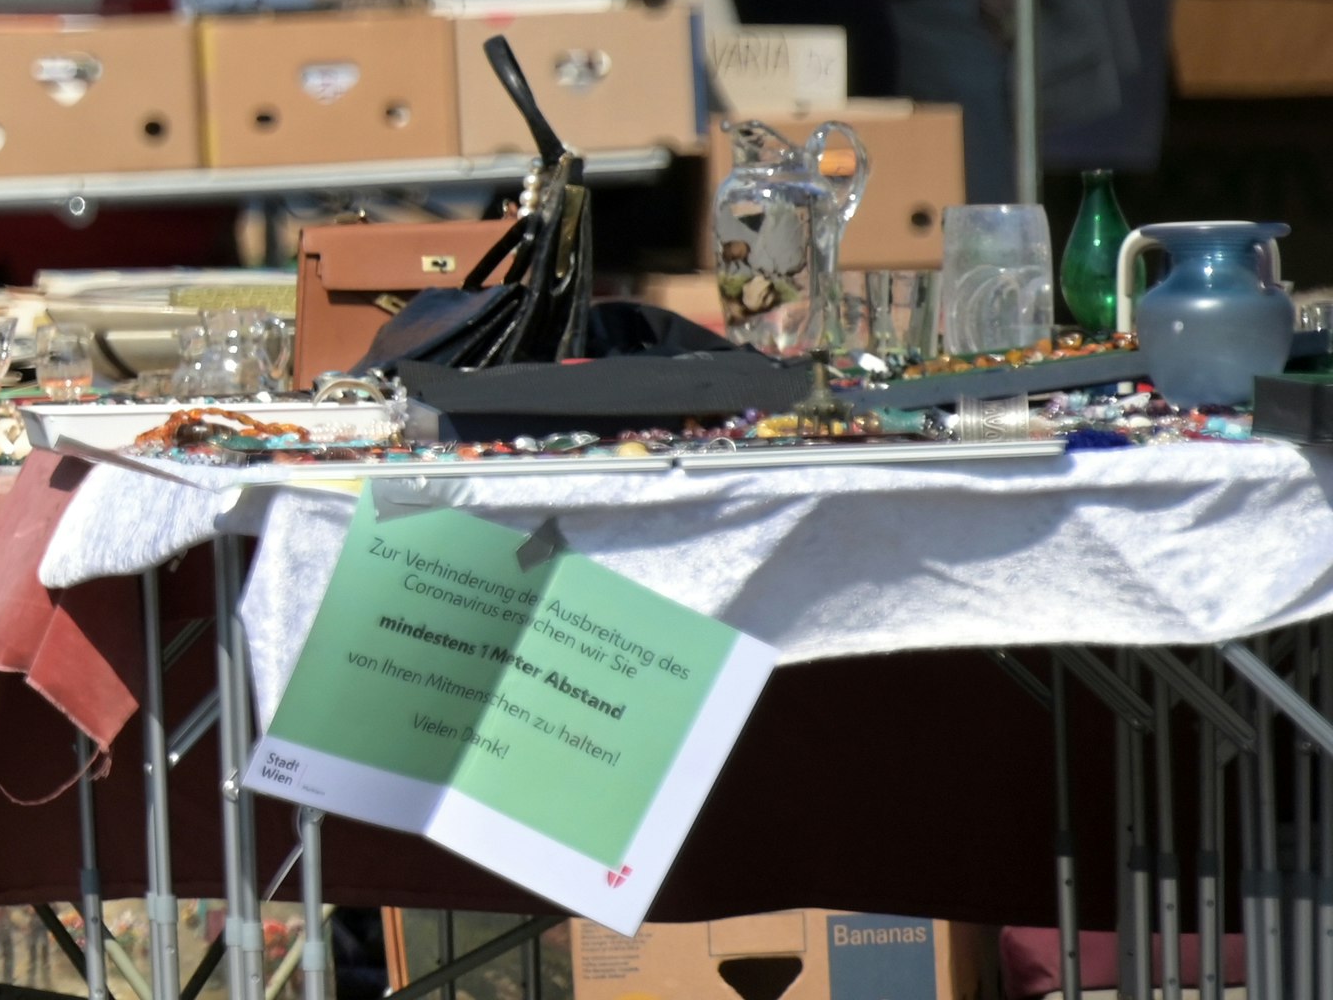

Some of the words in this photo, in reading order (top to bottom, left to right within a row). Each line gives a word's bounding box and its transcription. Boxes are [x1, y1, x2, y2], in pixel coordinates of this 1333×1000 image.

[712, 30, 791, 75] VARIA
[369, 537, 401, 561] Zur
[406, 549, 516, 604] Verhinderung
[546, 600, 656, 667] Ausbreitung
[658, 656, 691, 680] des
[404, 574, 499, 617] Coronavirus
[580, 642, 608, 663] wir
[610, 654, 638, 679] Sie
[379, 615, 477, 655] mindestens
[481, 644, 489, 658] 1
[490, 646, 543, 678] Meter
[544, 671, 627, 720] Abstand
[348, 651, 378, 671] von
[381, 658, 422, 685] Ihren
[425, 673, 531, 723] Mitmenschen
[533, 717, 556, 734] zu
[558, 724, 621, 767] halten!
[413, 712, 458, 740] Vielen
[462, 726, 510, 760] Dank!
[262, 766, 293, 786] Wien
[267, 752, 300, 772] Stadt
[833, 924, 927, 946] Bananas
